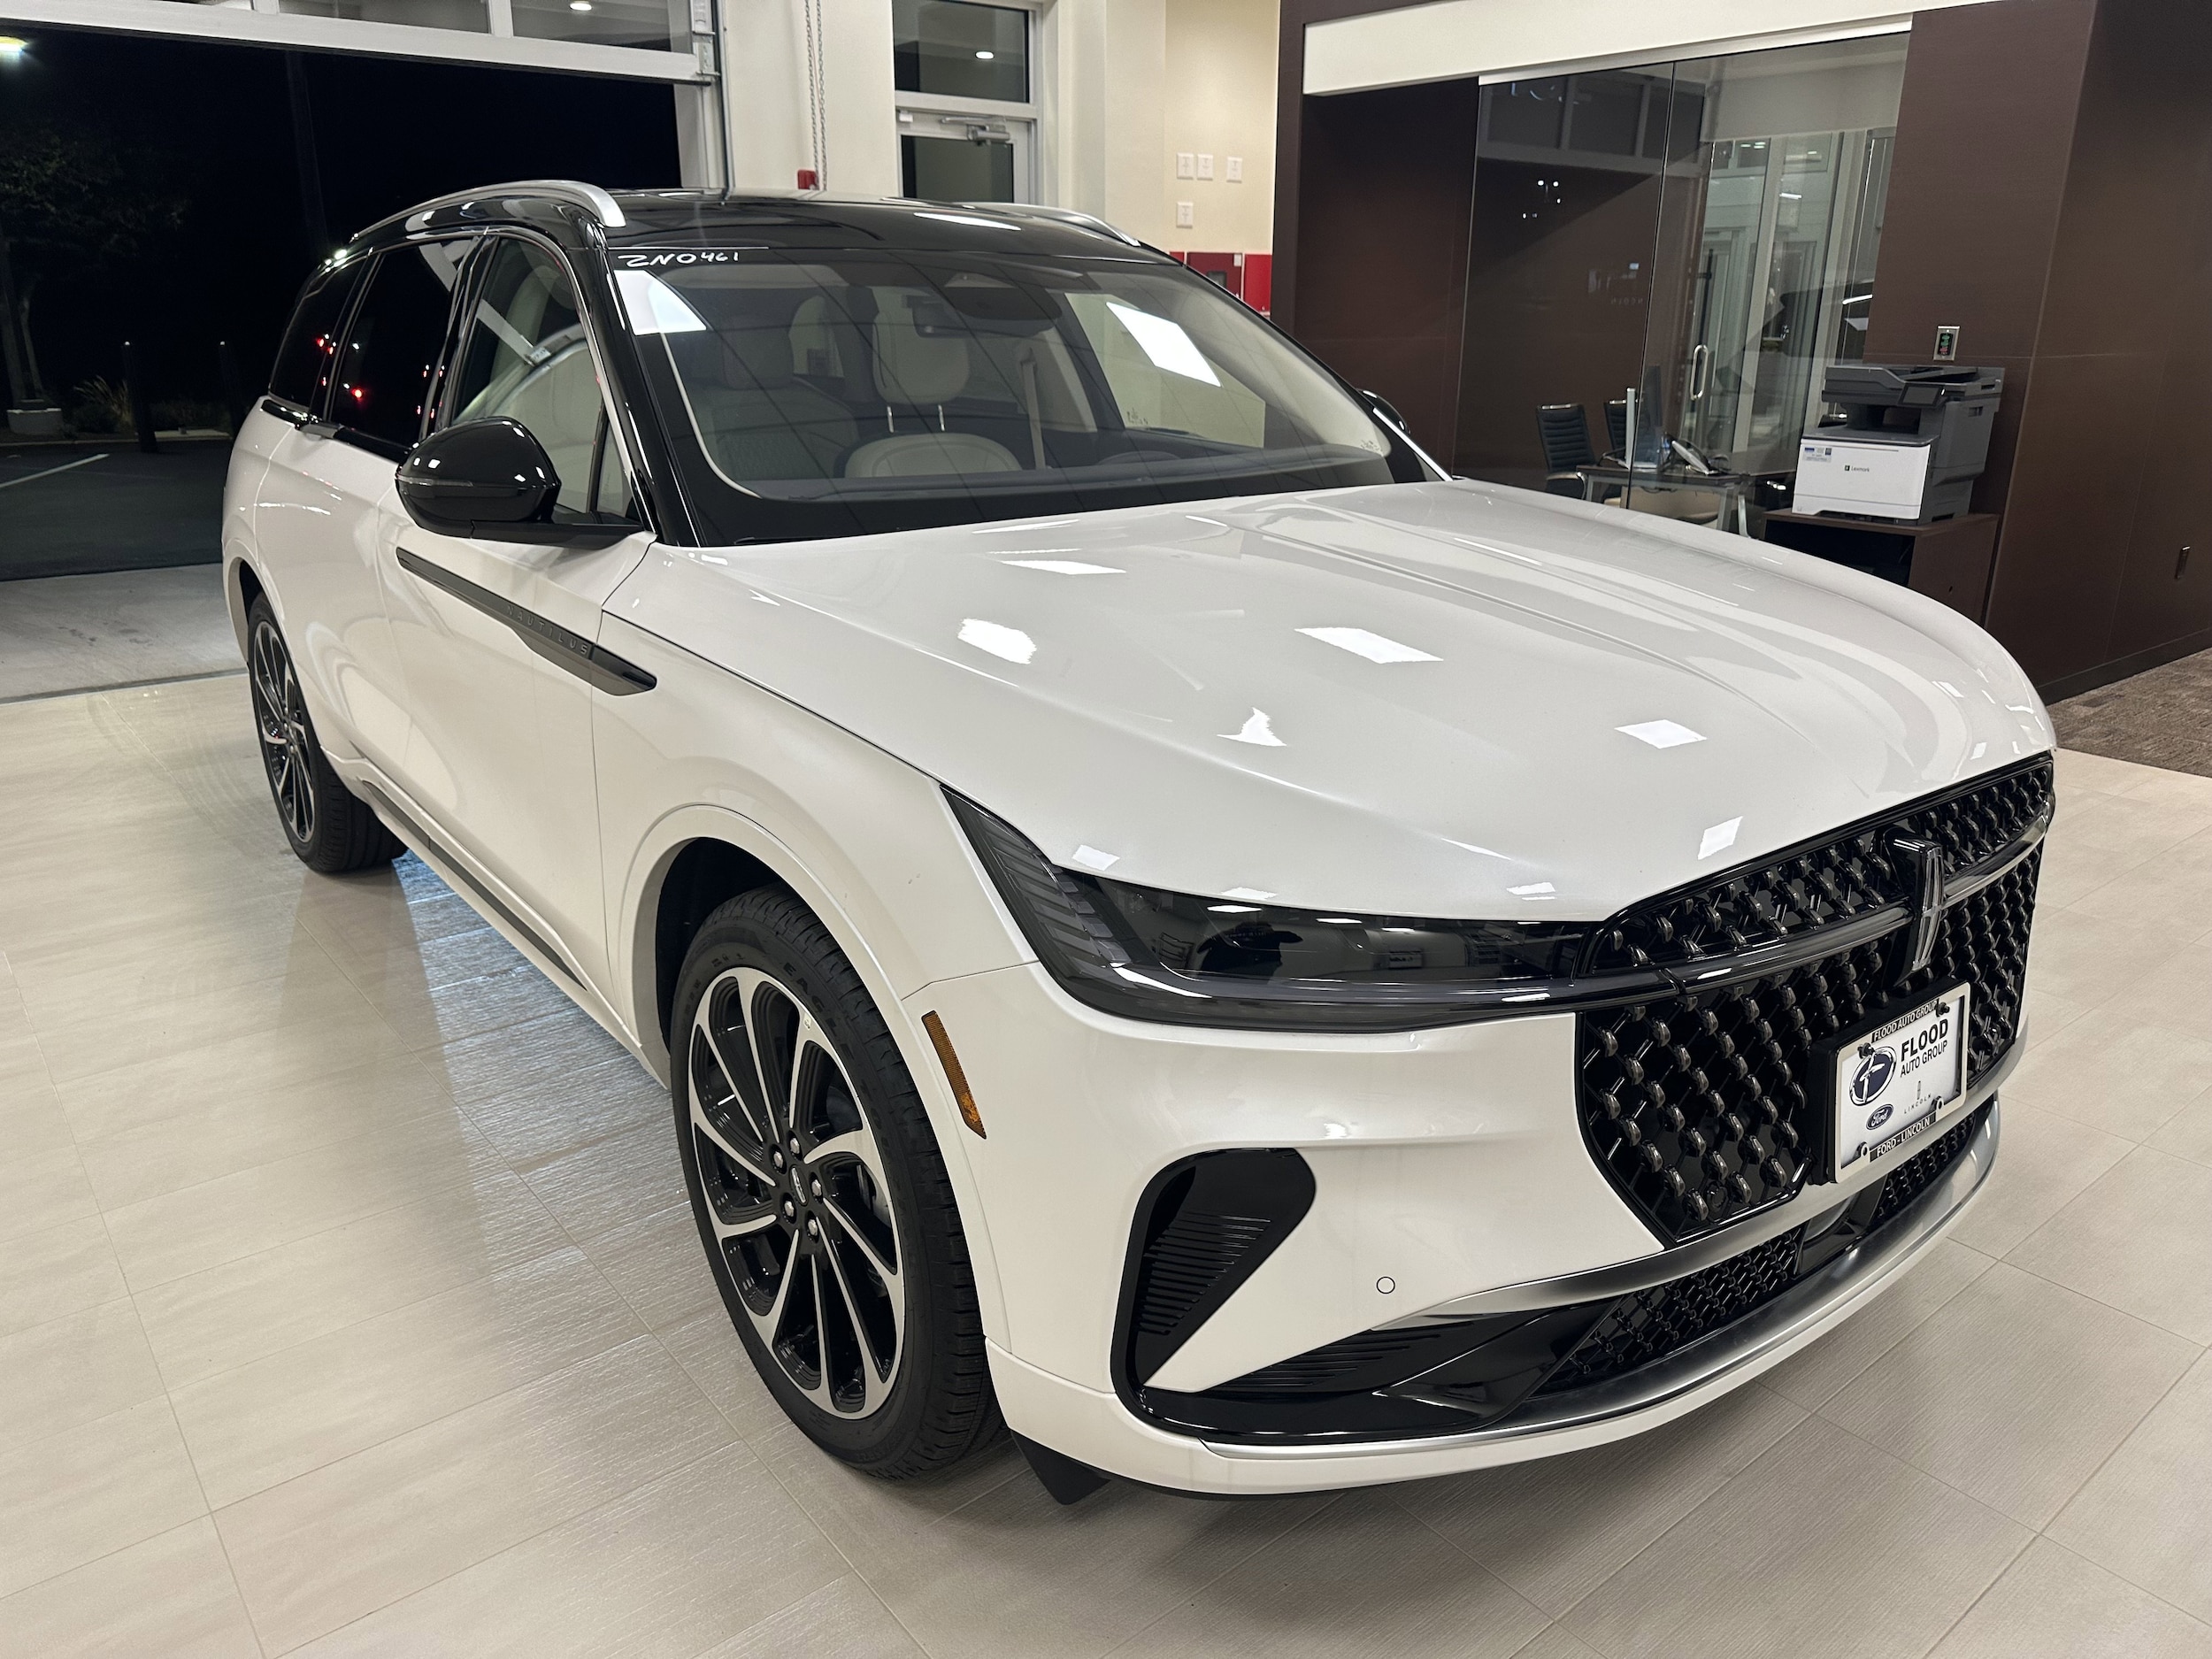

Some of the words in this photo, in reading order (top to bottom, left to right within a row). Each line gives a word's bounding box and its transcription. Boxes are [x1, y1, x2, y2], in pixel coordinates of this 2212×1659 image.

[508, 605, 588, 655] NAUTILUS
[1873, 1023, 1897, 1041] FLOOD
[1897, 1013, 1916, 1029] AUTO
[1916, 1000, 1937, 1019] GROUP
[1901, 1018, 1948, 1062] FLOOD
[1900, 1056, 1920, 1078] AUTO
[1922, 1040, 1947, 1064] GROUP
[1904, 1093, 1932, 1114] LINCOLN
